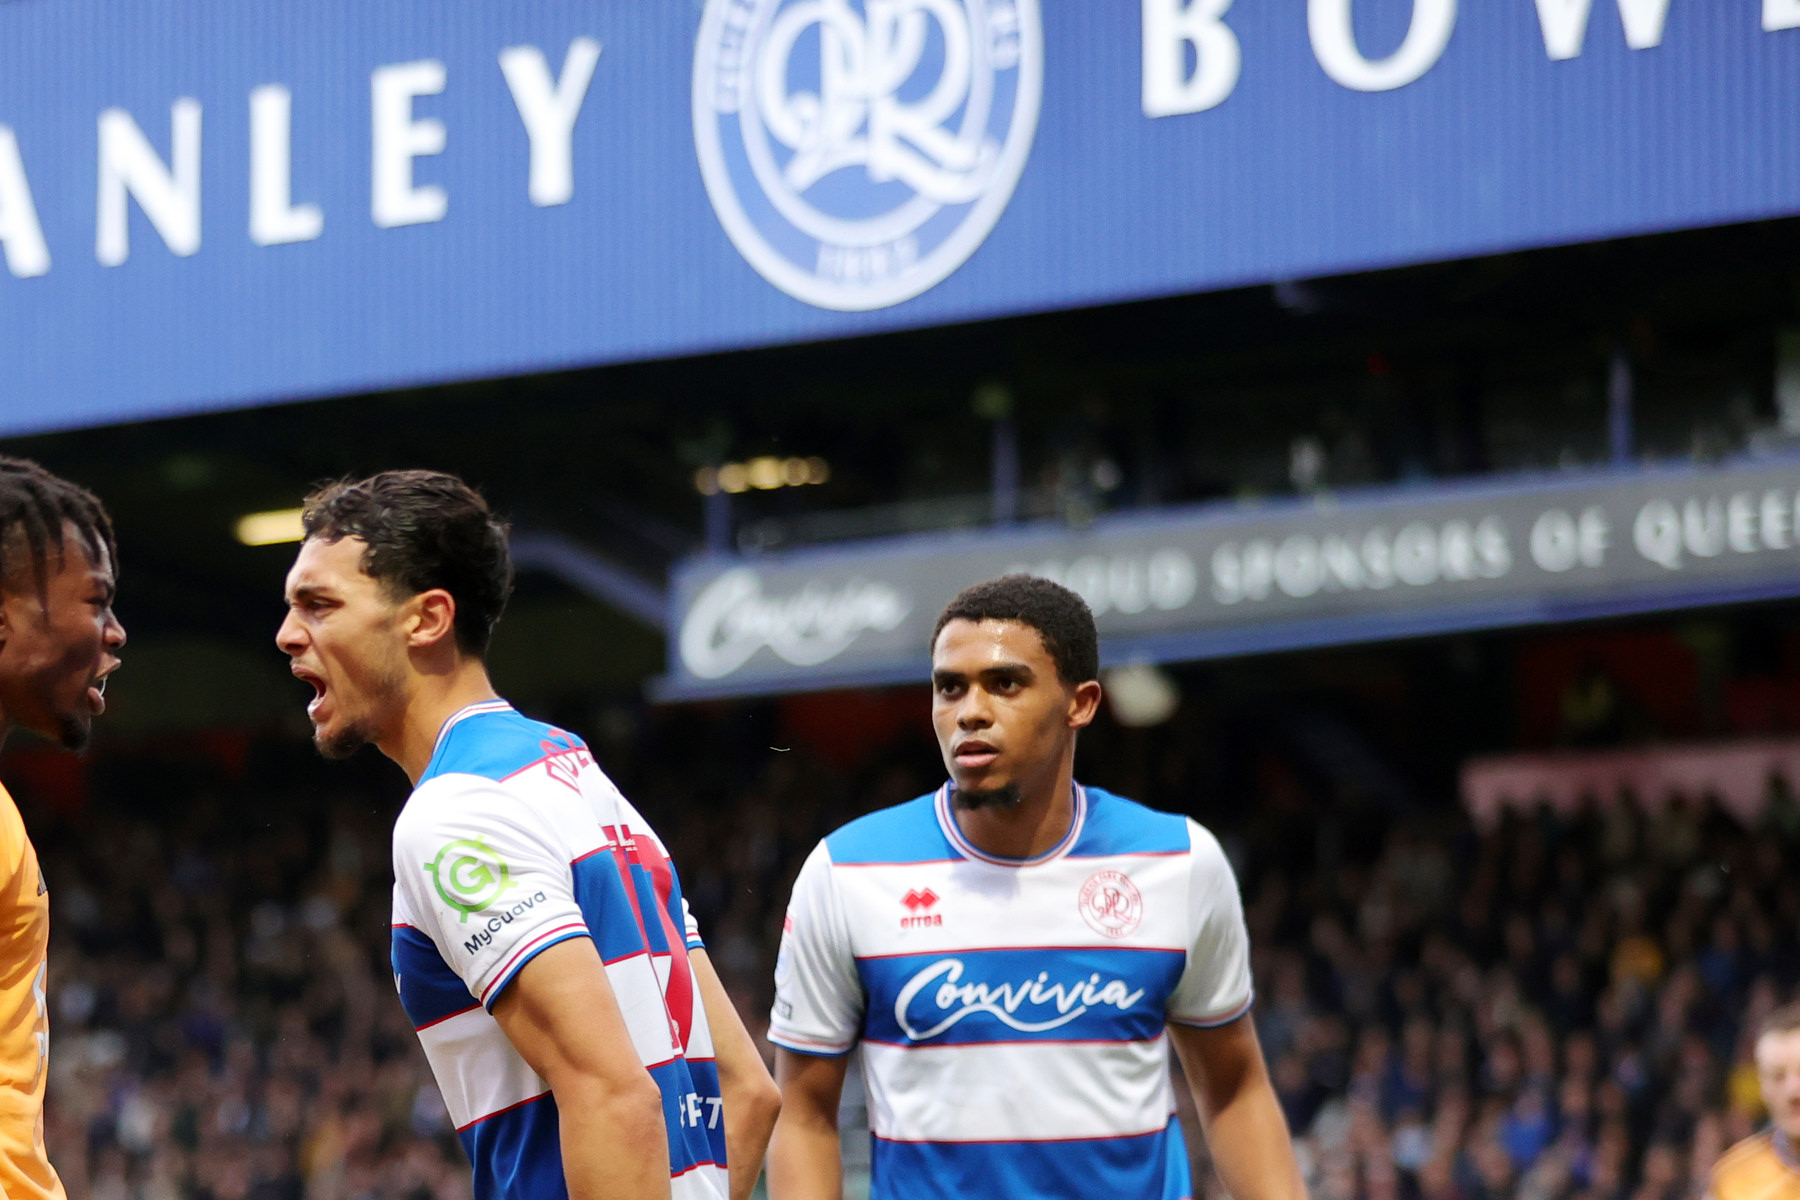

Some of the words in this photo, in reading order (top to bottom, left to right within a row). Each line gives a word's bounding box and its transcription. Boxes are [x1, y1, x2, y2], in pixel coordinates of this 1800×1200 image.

[1210, 515, 1513, 605] SPONSORS
[1529, 505, 1611, 573] OF
[1633, 488, 1800, 571] QUEE
[463, 891, 548, 956] MyGuava
[894, 958, 1146, 1041] Convivia
